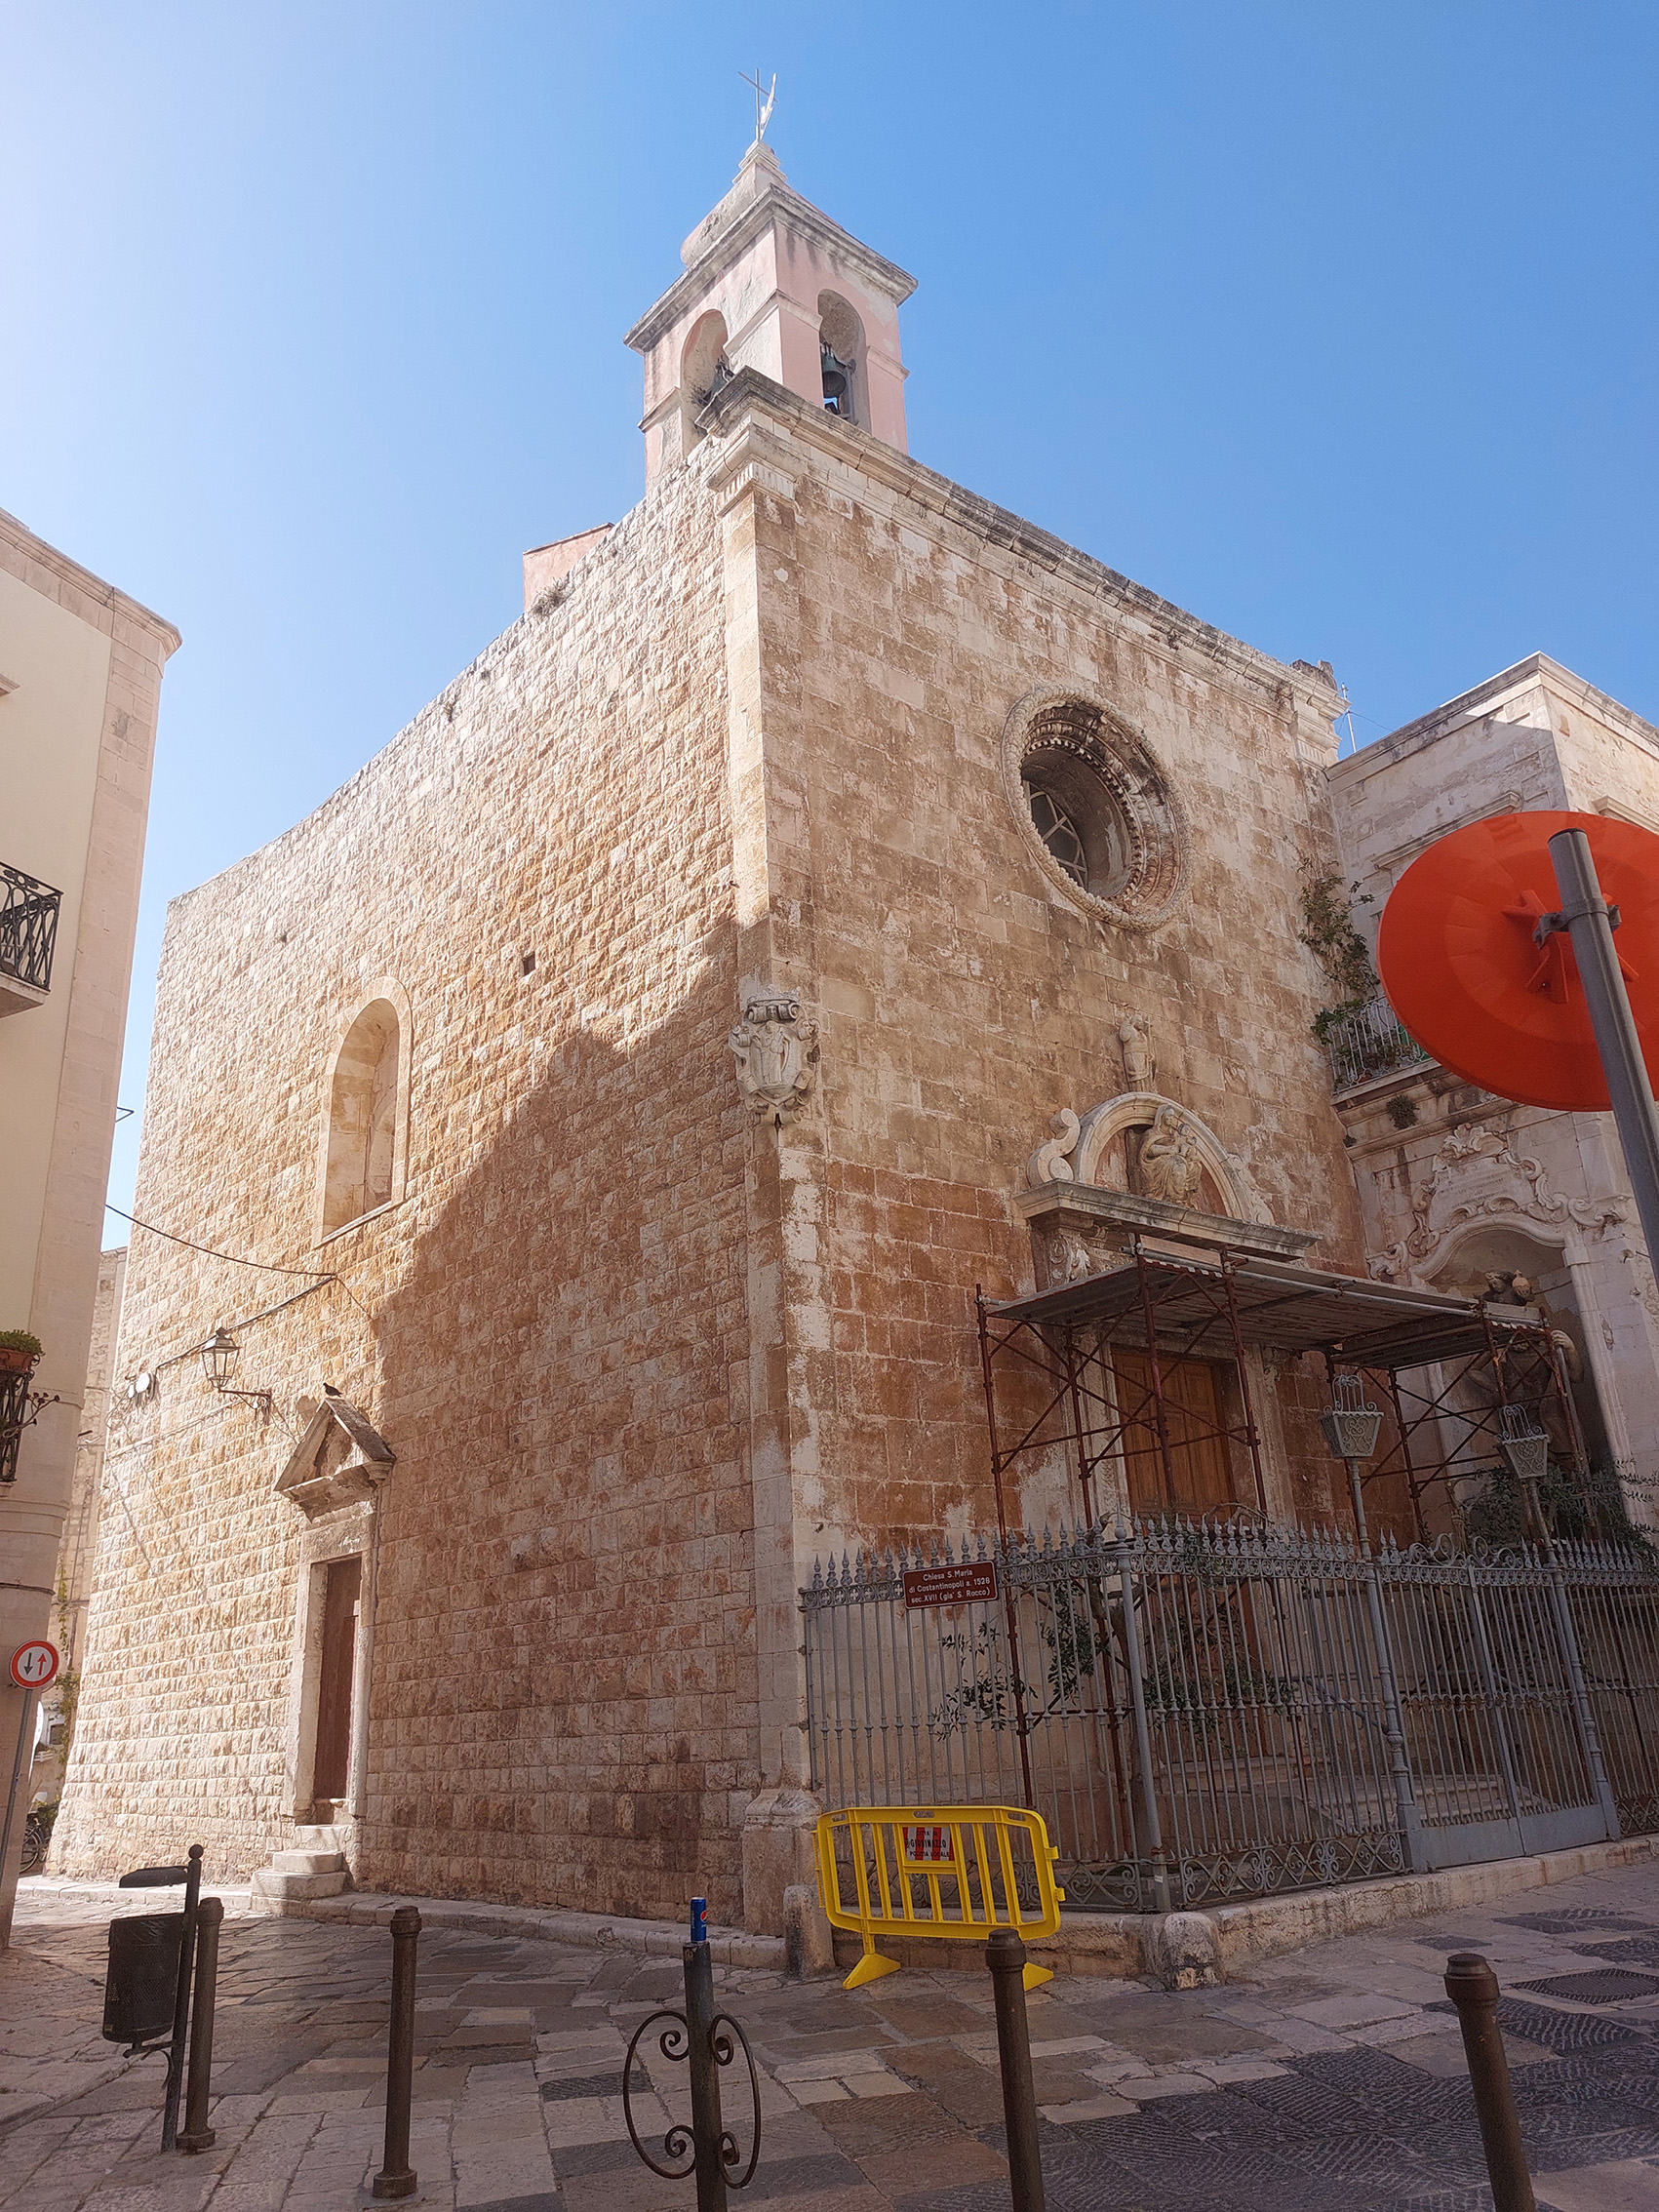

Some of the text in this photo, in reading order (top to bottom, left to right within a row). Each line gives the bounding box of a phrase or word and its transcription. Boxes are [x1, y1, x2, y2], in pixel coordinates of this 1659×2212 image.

[917, 1580, 965, 1593] Costantinopoli
[973, 1576, 991, 1586] 1528
[967, 1586, 991, 1597] Rocco)
